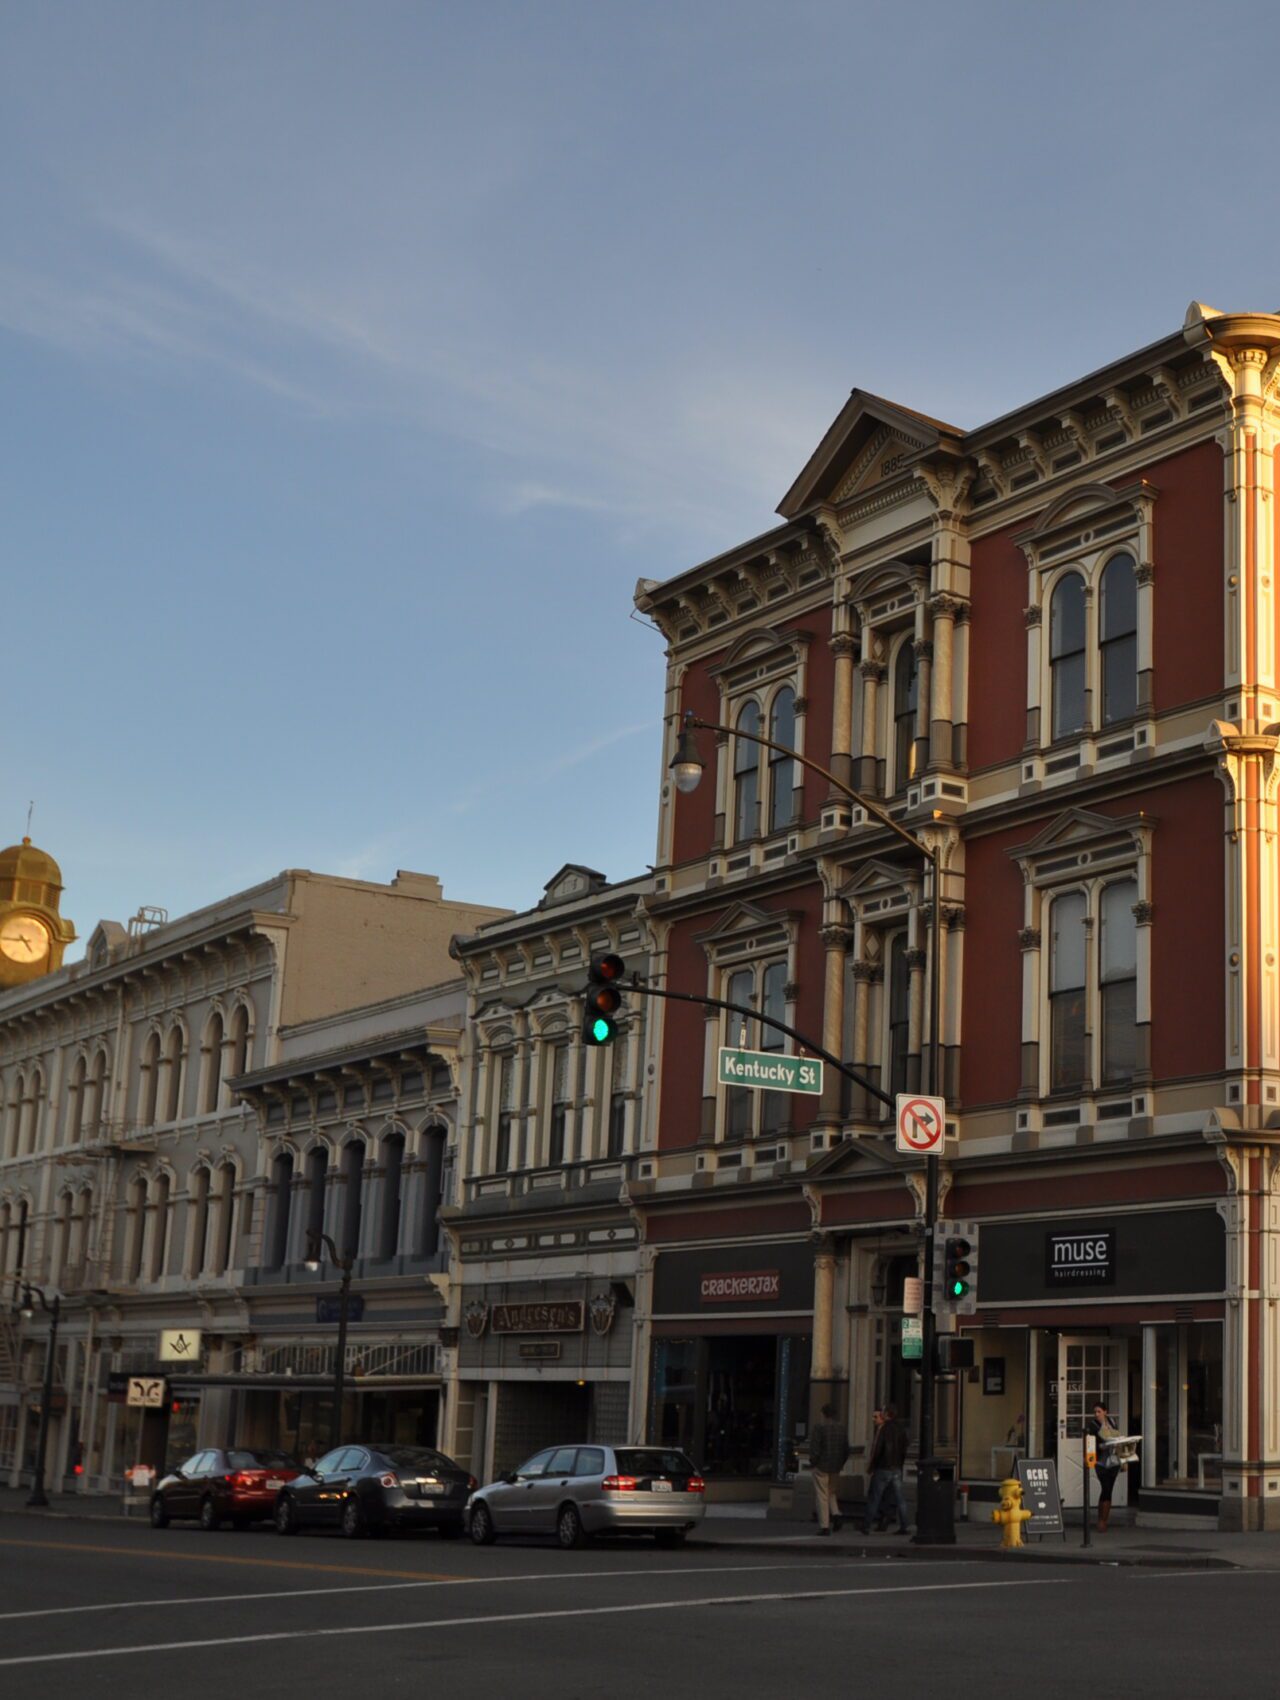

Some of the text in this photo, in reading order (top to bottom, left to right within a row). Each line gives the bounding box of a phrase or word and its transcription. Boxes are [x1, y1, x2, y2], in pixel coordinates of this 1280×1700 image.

[724, 1056, 816, 1086] Kentucky St
[1054, 1240, 1107, 1262] muse
[1054, 1268, 1106, 1278] hairdressing
